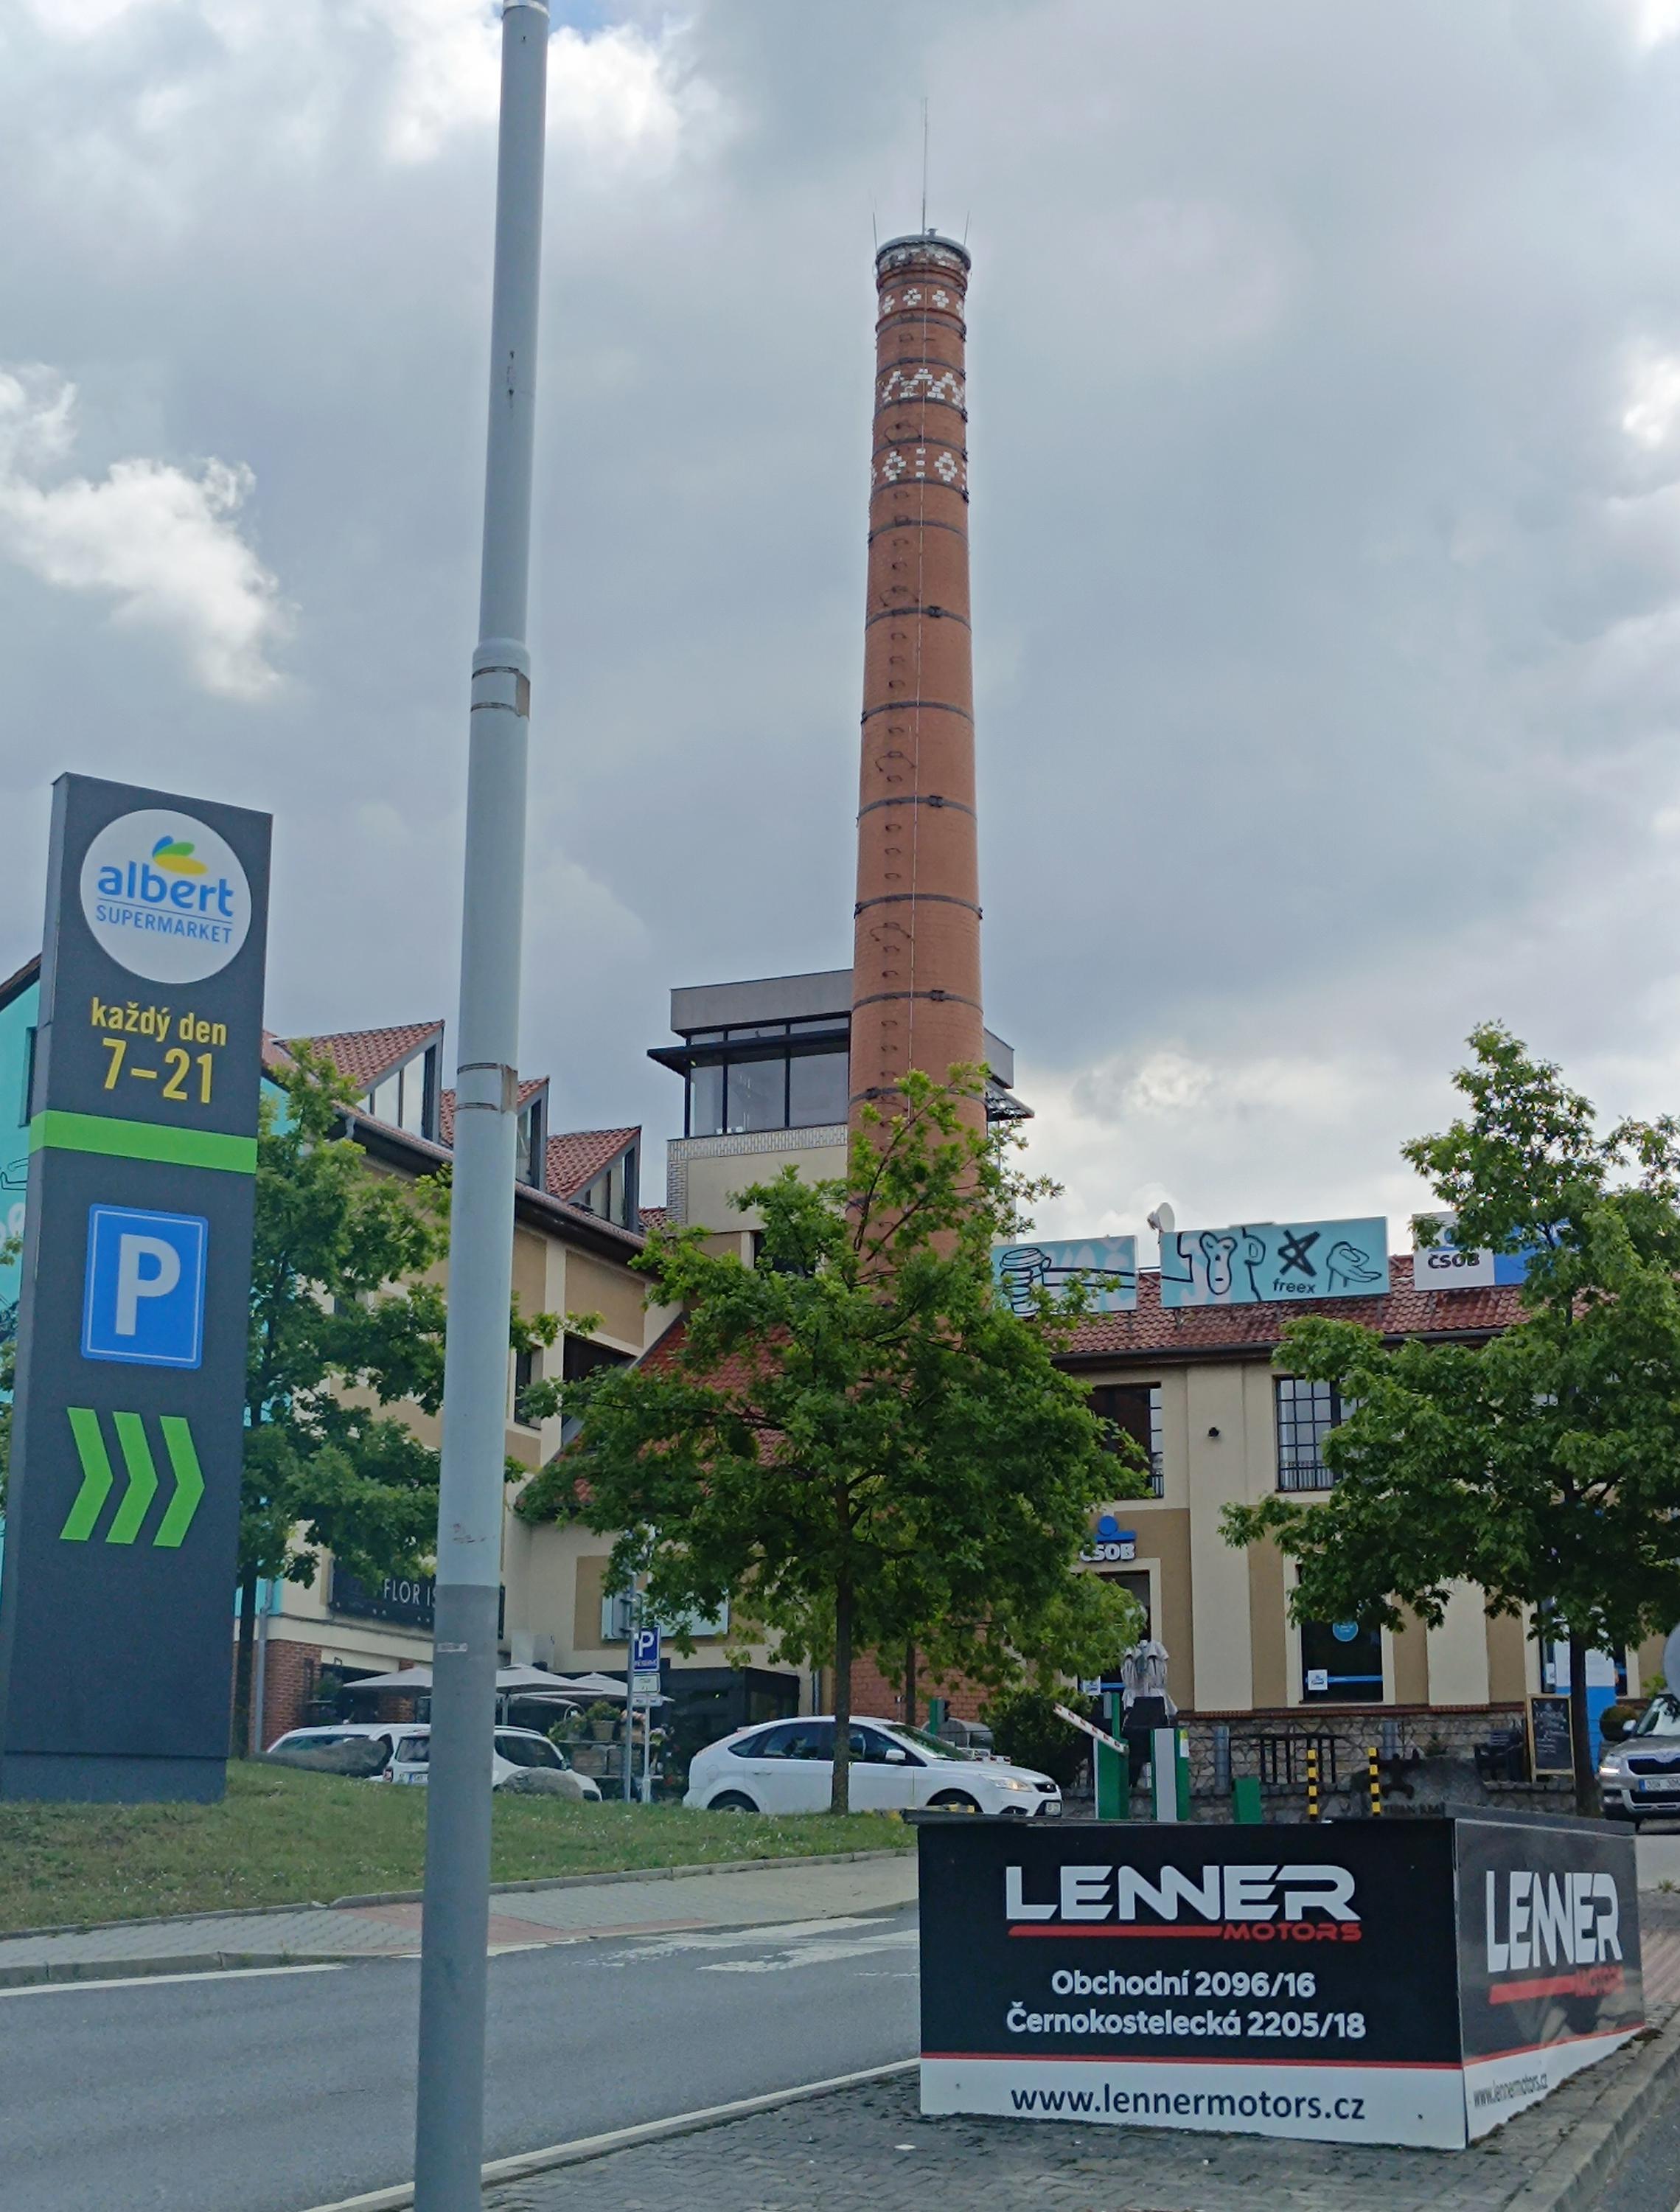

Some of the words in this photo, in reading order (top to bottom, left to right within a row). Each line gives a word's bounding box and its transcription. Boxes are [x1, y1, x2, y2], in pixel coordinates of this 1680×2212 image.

[98, 860, 234, 917] albert
[96, 905, 232, 944] SUPERMARKET
[91, 997, 171, 1042] každý
[179, 1012, 226, 1046] den
[115, 1234, 181, 1335] P
[1272, 1277, 1316, 1293] freex
[383, 1578, 420, 1606] FLOR
[638, 1630, 655, 1658] P
[1005, 1865, 1362, 1921] LENNER
[1222, 1921, 1363, 1941] MOTORS
[1485, 1870, 1623, 1973] LENNER
[1051, 1969, 1190, 1996] Obchodní
[1194, 1972, 1317, 1998] 2096/16
[1006, 2001, 1241, 2035] Černokostelecká
[1247, 2011, 1367, 2039] 2205/18
[1011, 2082, 1366, 2120] www.lennermotors.cz
